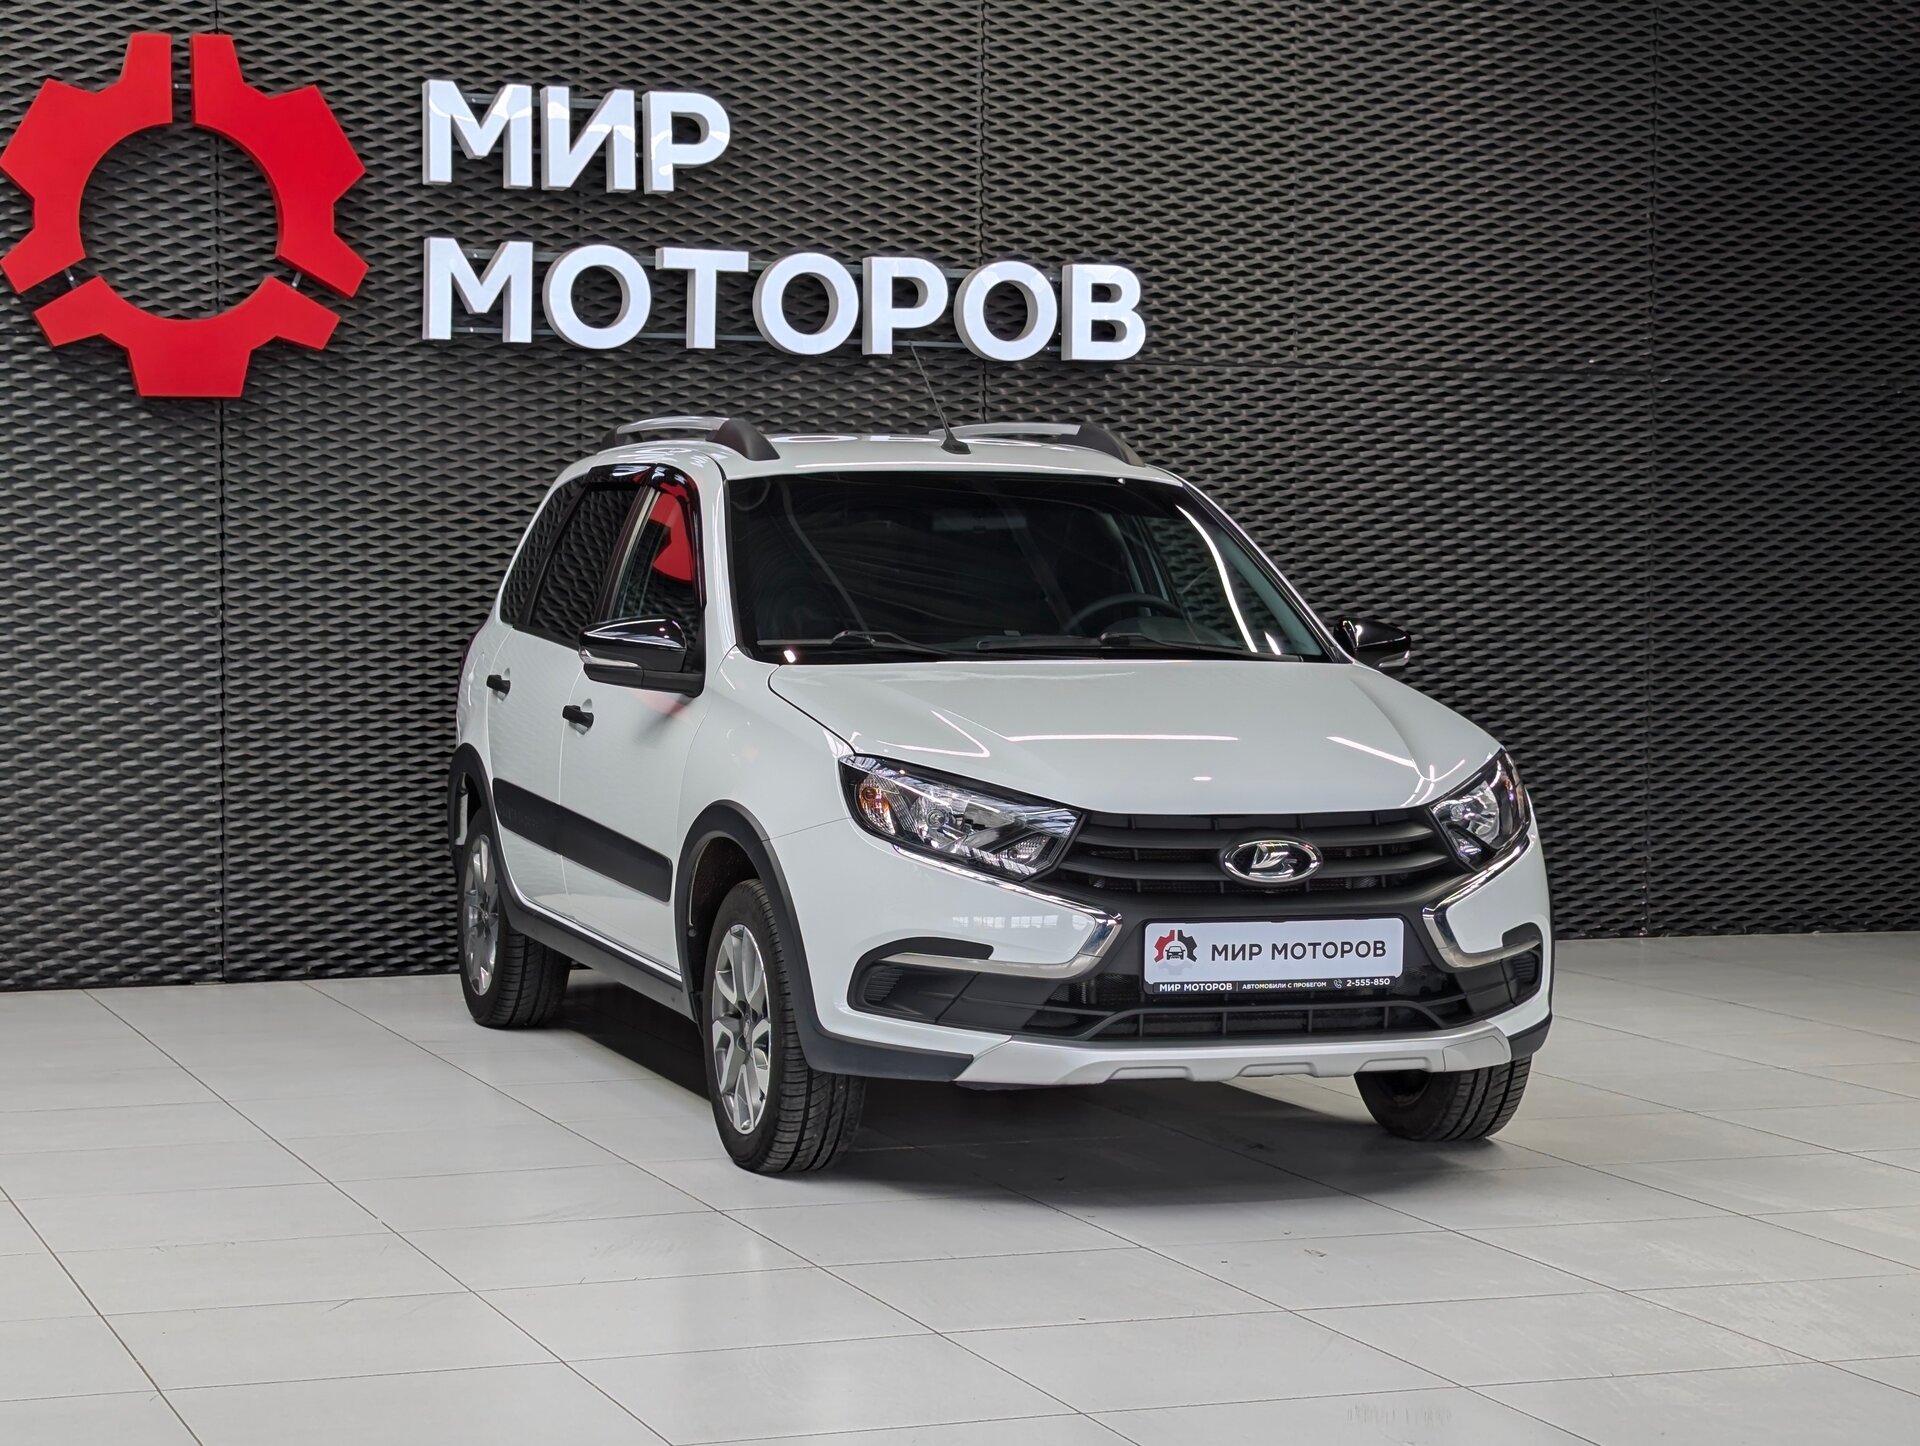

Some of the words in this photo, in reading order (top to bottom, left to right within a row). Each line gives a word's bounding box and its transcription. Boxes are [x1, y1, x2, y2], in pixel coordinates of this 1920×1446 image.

[422, 79, 731, 194] МИР
[422, 237, 1146, 361] МОТОРОВ
[1211, 943, 1263, 961] МИР
[1271, 940, 1387, 960] МОТОРОВ
[1159, 983, 1181, 992] МИР
[1183, 982, 1233, 992] МОТОРОВ
[1346, 978, 1391, 987] 2-555-850
